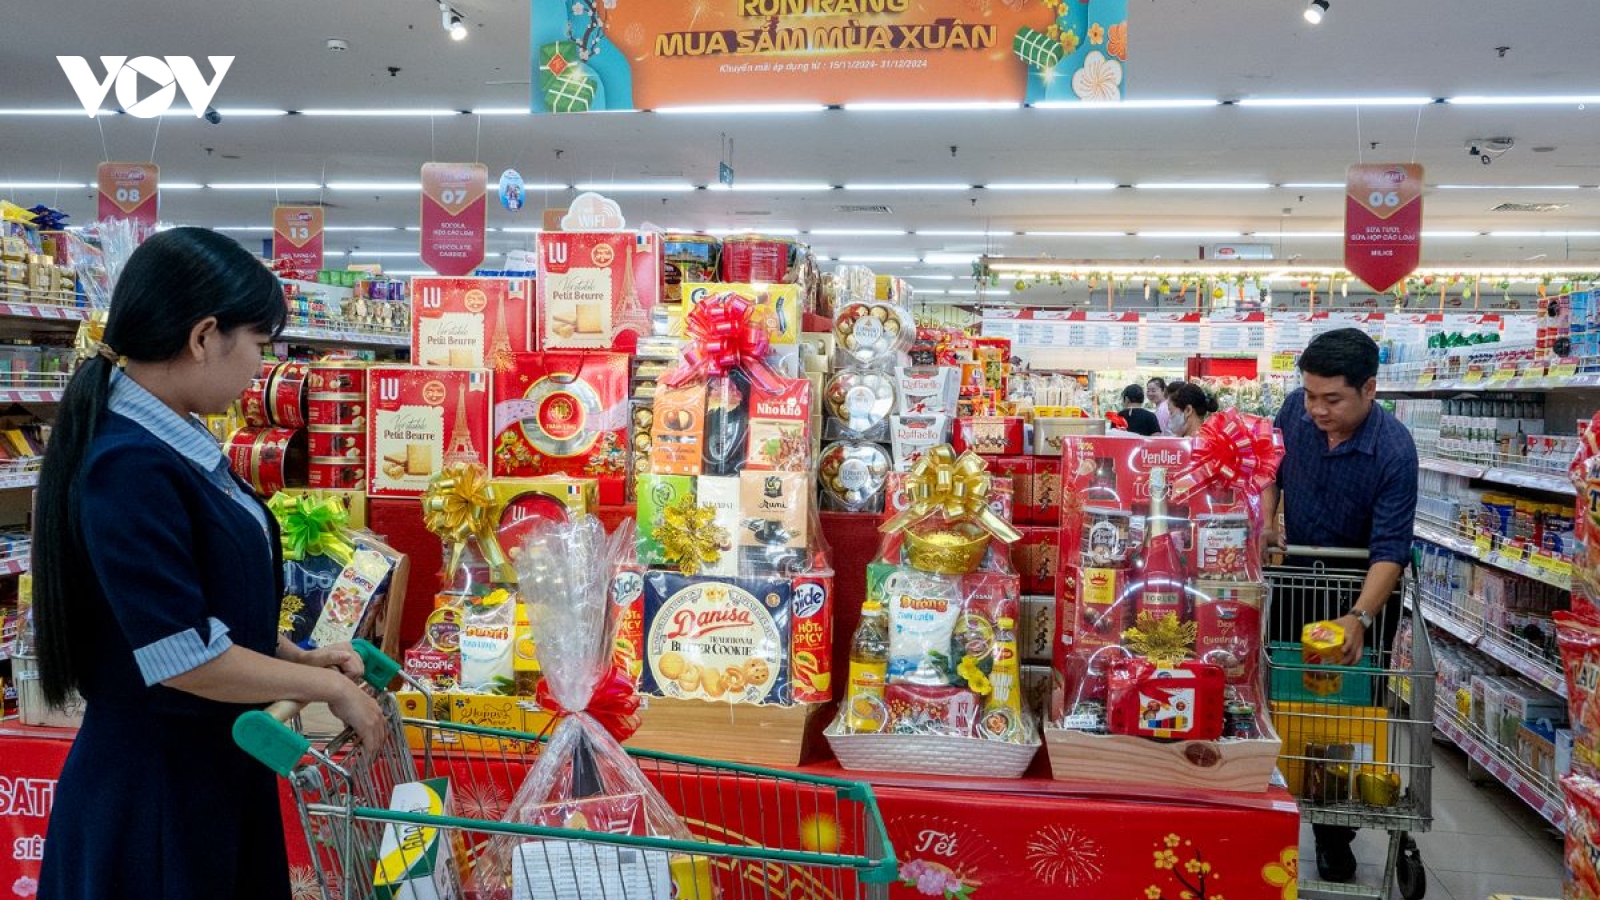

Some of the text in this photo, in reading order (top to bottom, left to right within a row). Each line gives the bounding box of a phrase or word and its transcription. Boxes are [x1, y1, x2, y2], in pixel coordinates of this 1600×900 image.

[655, 18, 998, 57] MUA SẮM MÙA XUÂN
[785, 61, 809, 72] dụng
[116, 188, 140, 203] 08
[440, 189, 467, 205] 07
[1368, 191, 1400, 208] 06
[290, 227, 309, 239] 13
[548, 241, 568, 264] LU
[423, 286, 441, 309] LU
[552, 291, 605, 301] Petit Beurre
[427, 335, 477, 346] Petit Beurre
[380, 378, 400, 401] LU
[902, 379, 942, 390] Raffaello
[383, 429, 435, 441] Petit Beurre
[897, 428, 939, 440] Raffaello
[668, 606, 754, 640] Danisa
[798, 620, 819, 633] HOT
[709, 635, 754, 645] TRADITIONAL
[795, 631, 823, 646] SPICY
[671, 640, 710, 656] BUER
[0, 775, 59, 817] SAT
[13, 834, 46, 860] SIÊ
[915, 830, 958, 857] Tết
